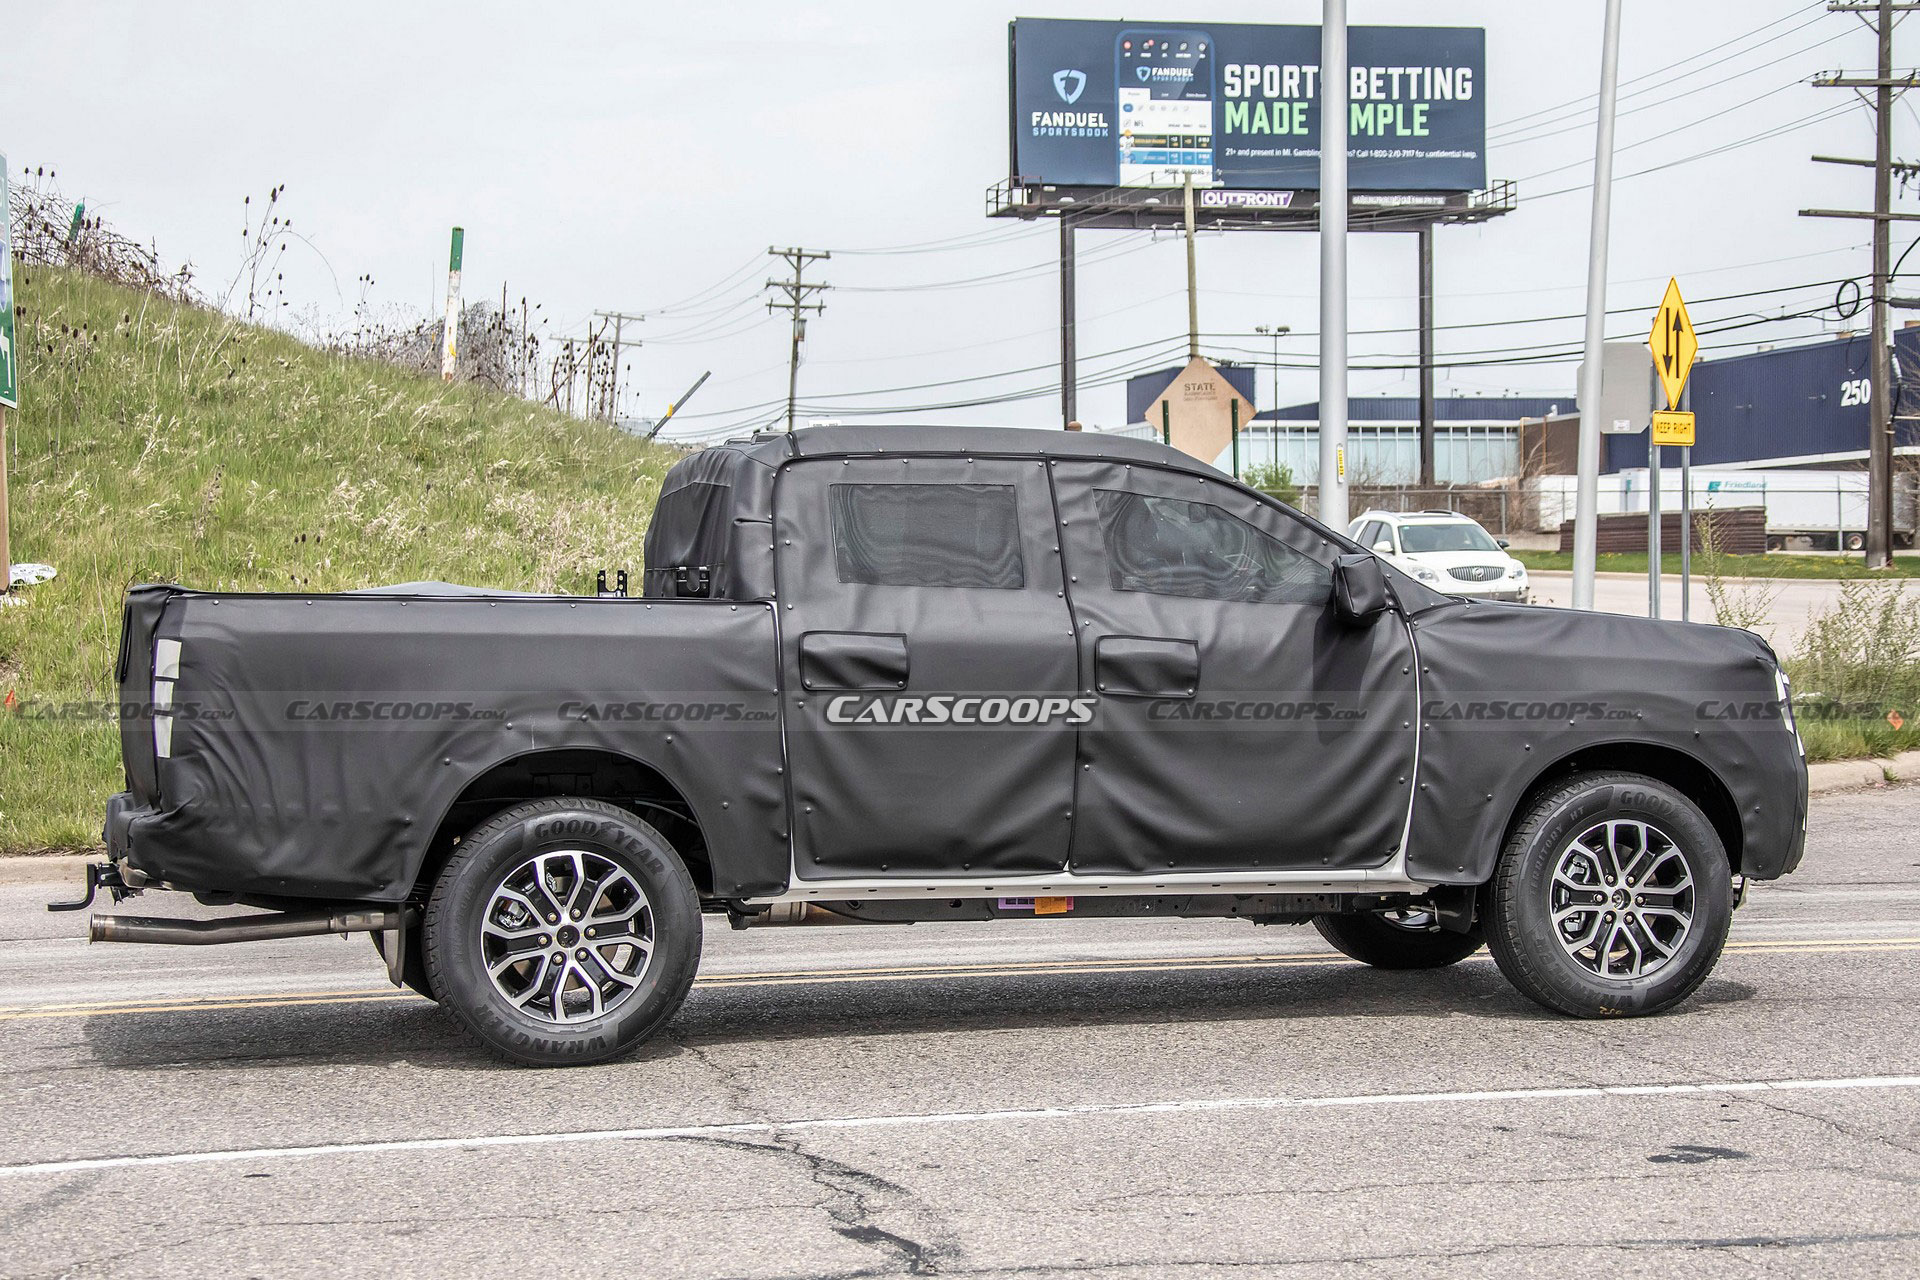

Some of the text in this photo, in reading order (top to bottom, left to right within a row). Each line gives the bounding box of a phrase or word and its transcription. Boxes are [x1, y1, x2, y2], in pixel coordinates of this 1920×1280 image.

[1151, 67, 1194, 76] FANDUEL
[1224, 64, 1473, 100] SPORT BETTING
[1031, 111, 1109, 128] FANDUEL
[1224, 101, 1430, 136] MADE MPLE
[1032, 127, 1109, 137] SPORTSBOOK
[1225, 148, 1236, 157] 21+
[1237, 149, 1250, 157] and
[1250, 149, 1275, 159] present
[1275, 149, 1282, 157] in
[1356, 150, 1369, 158] Call
[1415, 150, 1425, 158] for
[1204, 191, 1289, 206] OUTFRONT
[1840, 378, 1872, 407] 250
[1724, 481, 1767, 489] Friedland
[534, 818, 666, 876] GOODYEAR
